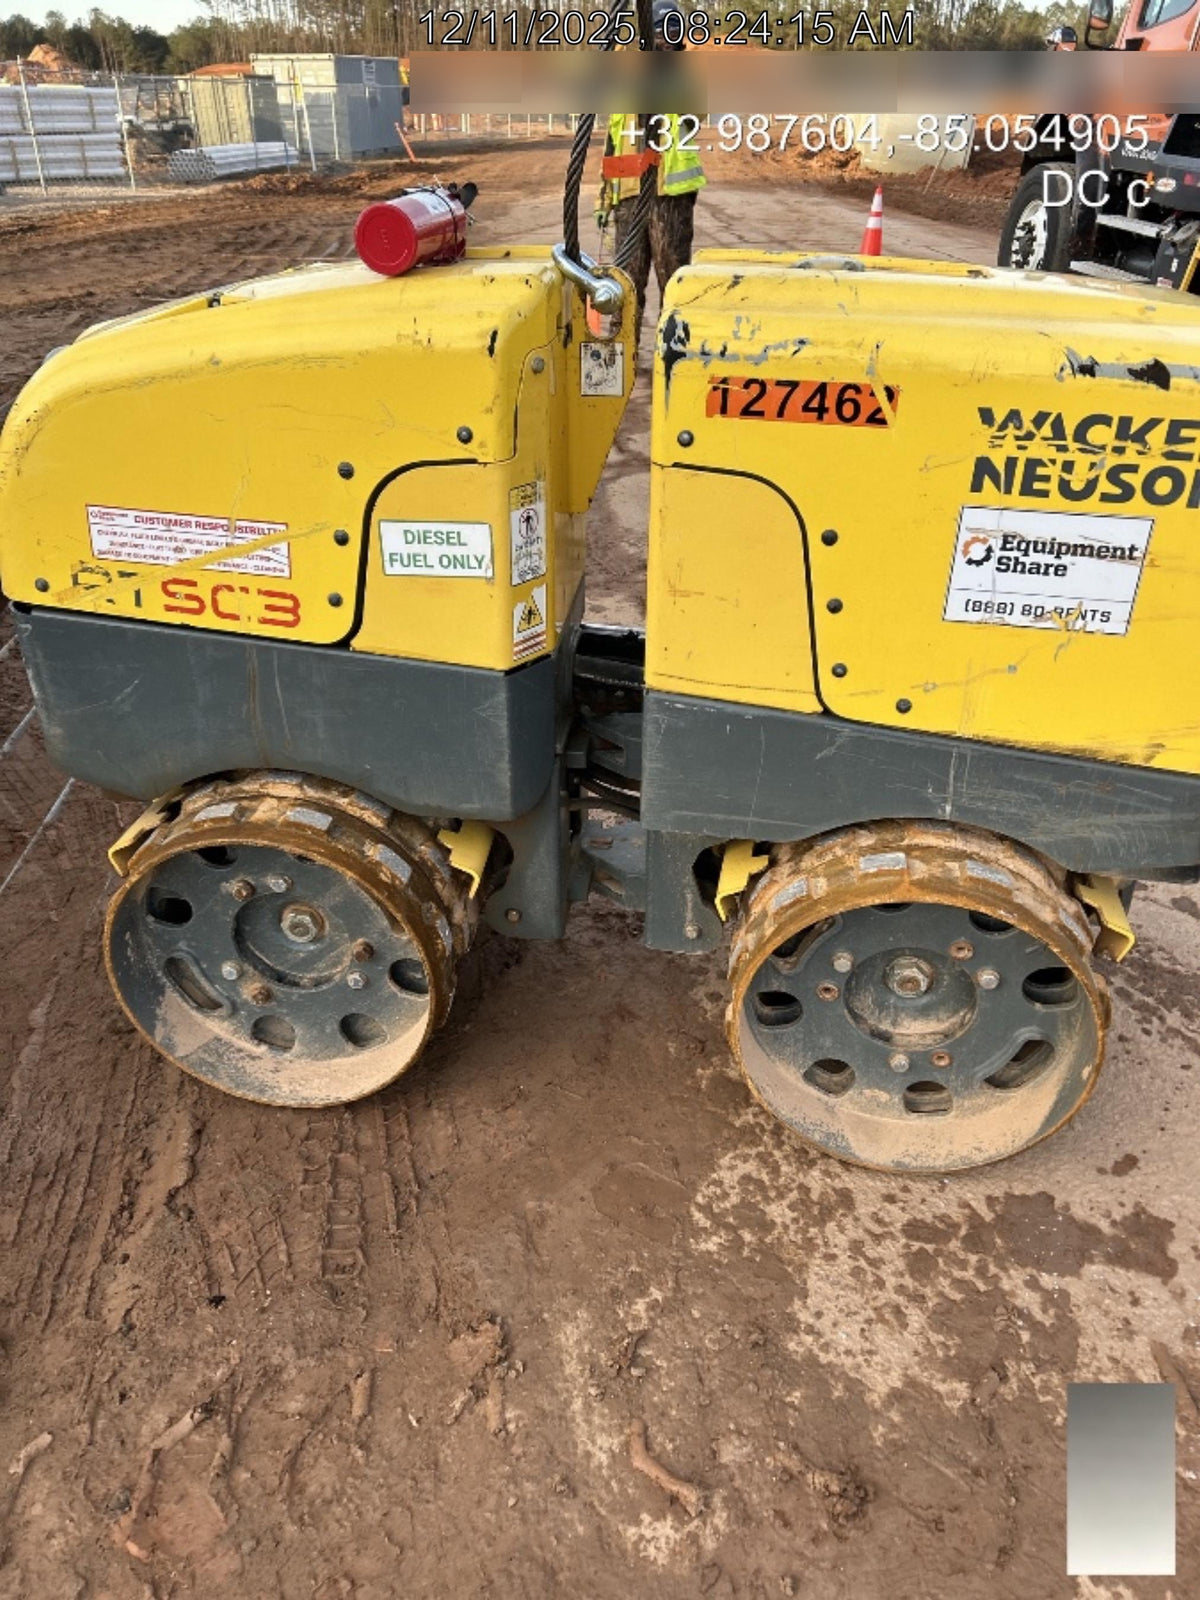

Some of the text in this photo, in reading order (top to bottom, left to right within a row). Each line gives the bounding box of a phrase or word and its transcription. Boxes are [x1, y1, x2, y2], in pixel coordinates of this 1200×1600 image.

[712, 376, 896, 426] 127462
[977, 406, 1200, 463] WACKE
[134, 514, 193, 529] CUSTOMER
[403, 529, 469, 547] DIESEL
[998, 533, 1142, 561] Equipment
[388, 552, 486, 570] FUEL ONLY
[995, 554, 1069, 577] Share
[964, 598, 1015, 616] (888)
